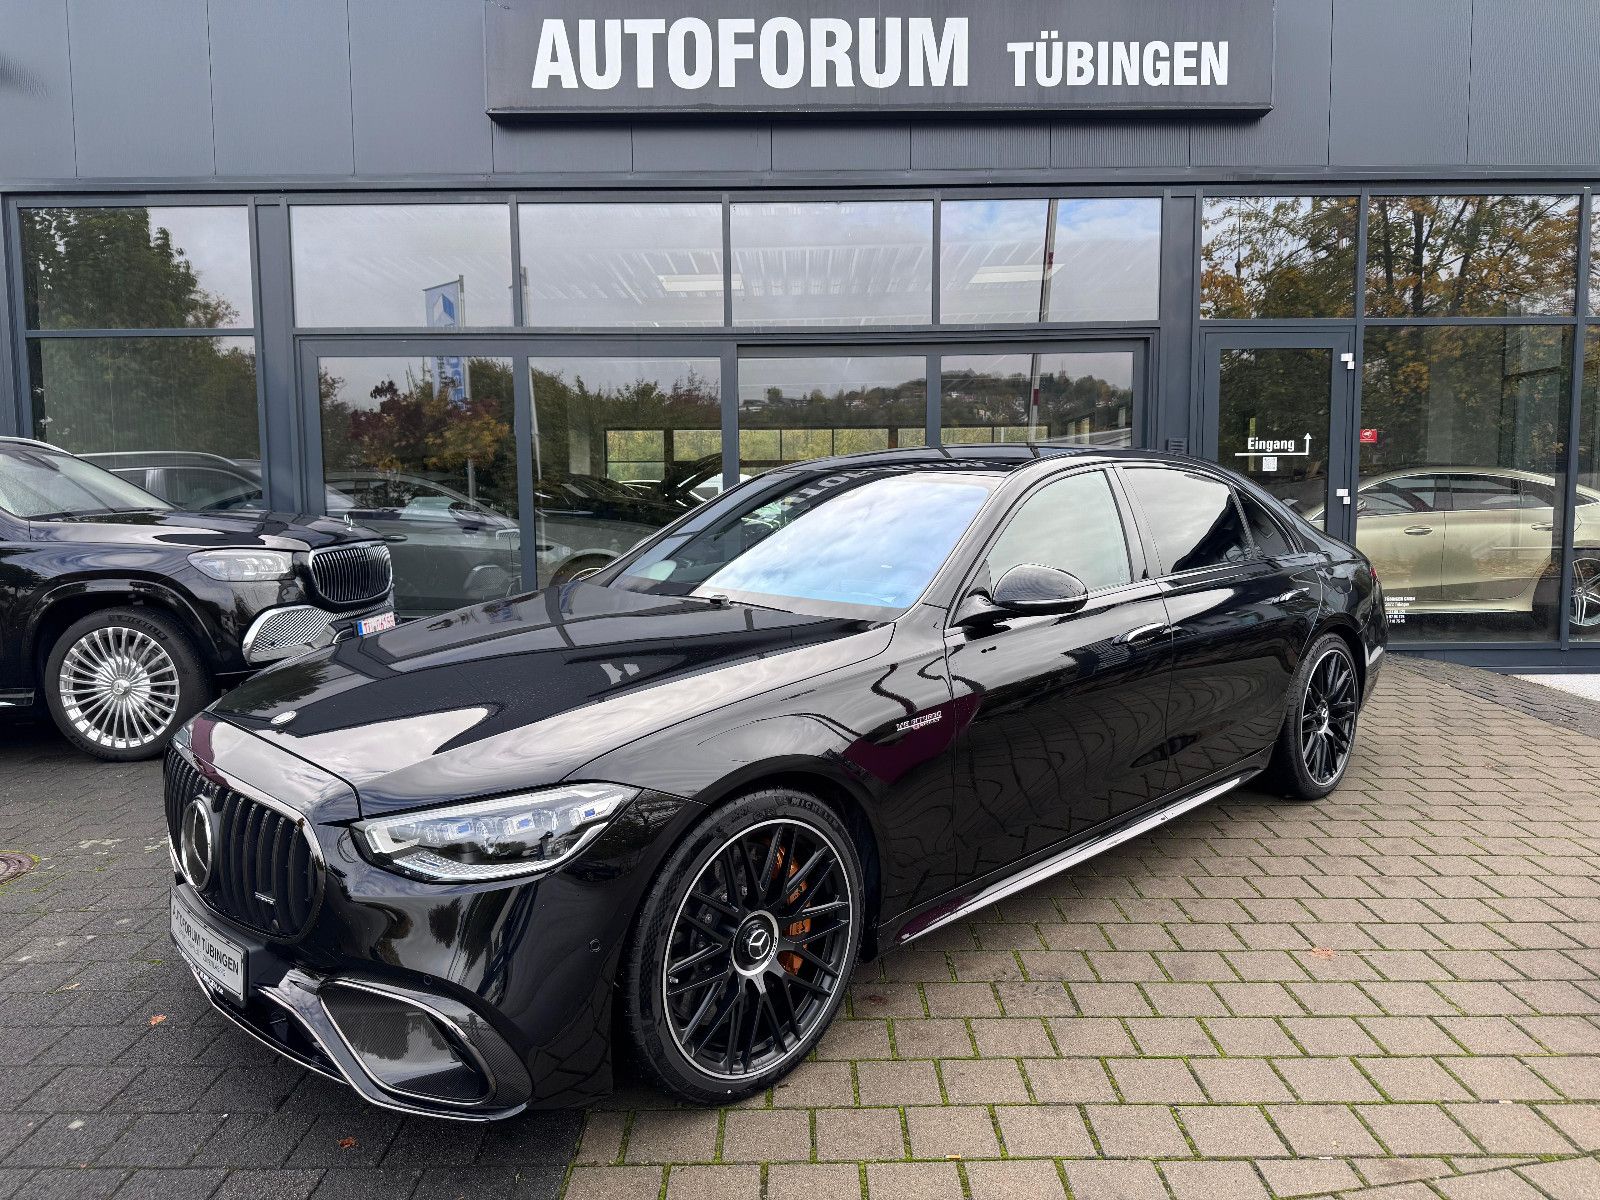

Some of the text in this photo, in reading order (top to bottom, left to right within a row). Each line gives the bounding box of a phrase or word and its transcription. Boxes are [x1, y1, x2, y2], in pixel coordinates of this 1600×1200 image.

[531, 16, 1229, 90] AUTOFORUM TÜBINGEN
[1247, 437, 1295, 452] Eingang
